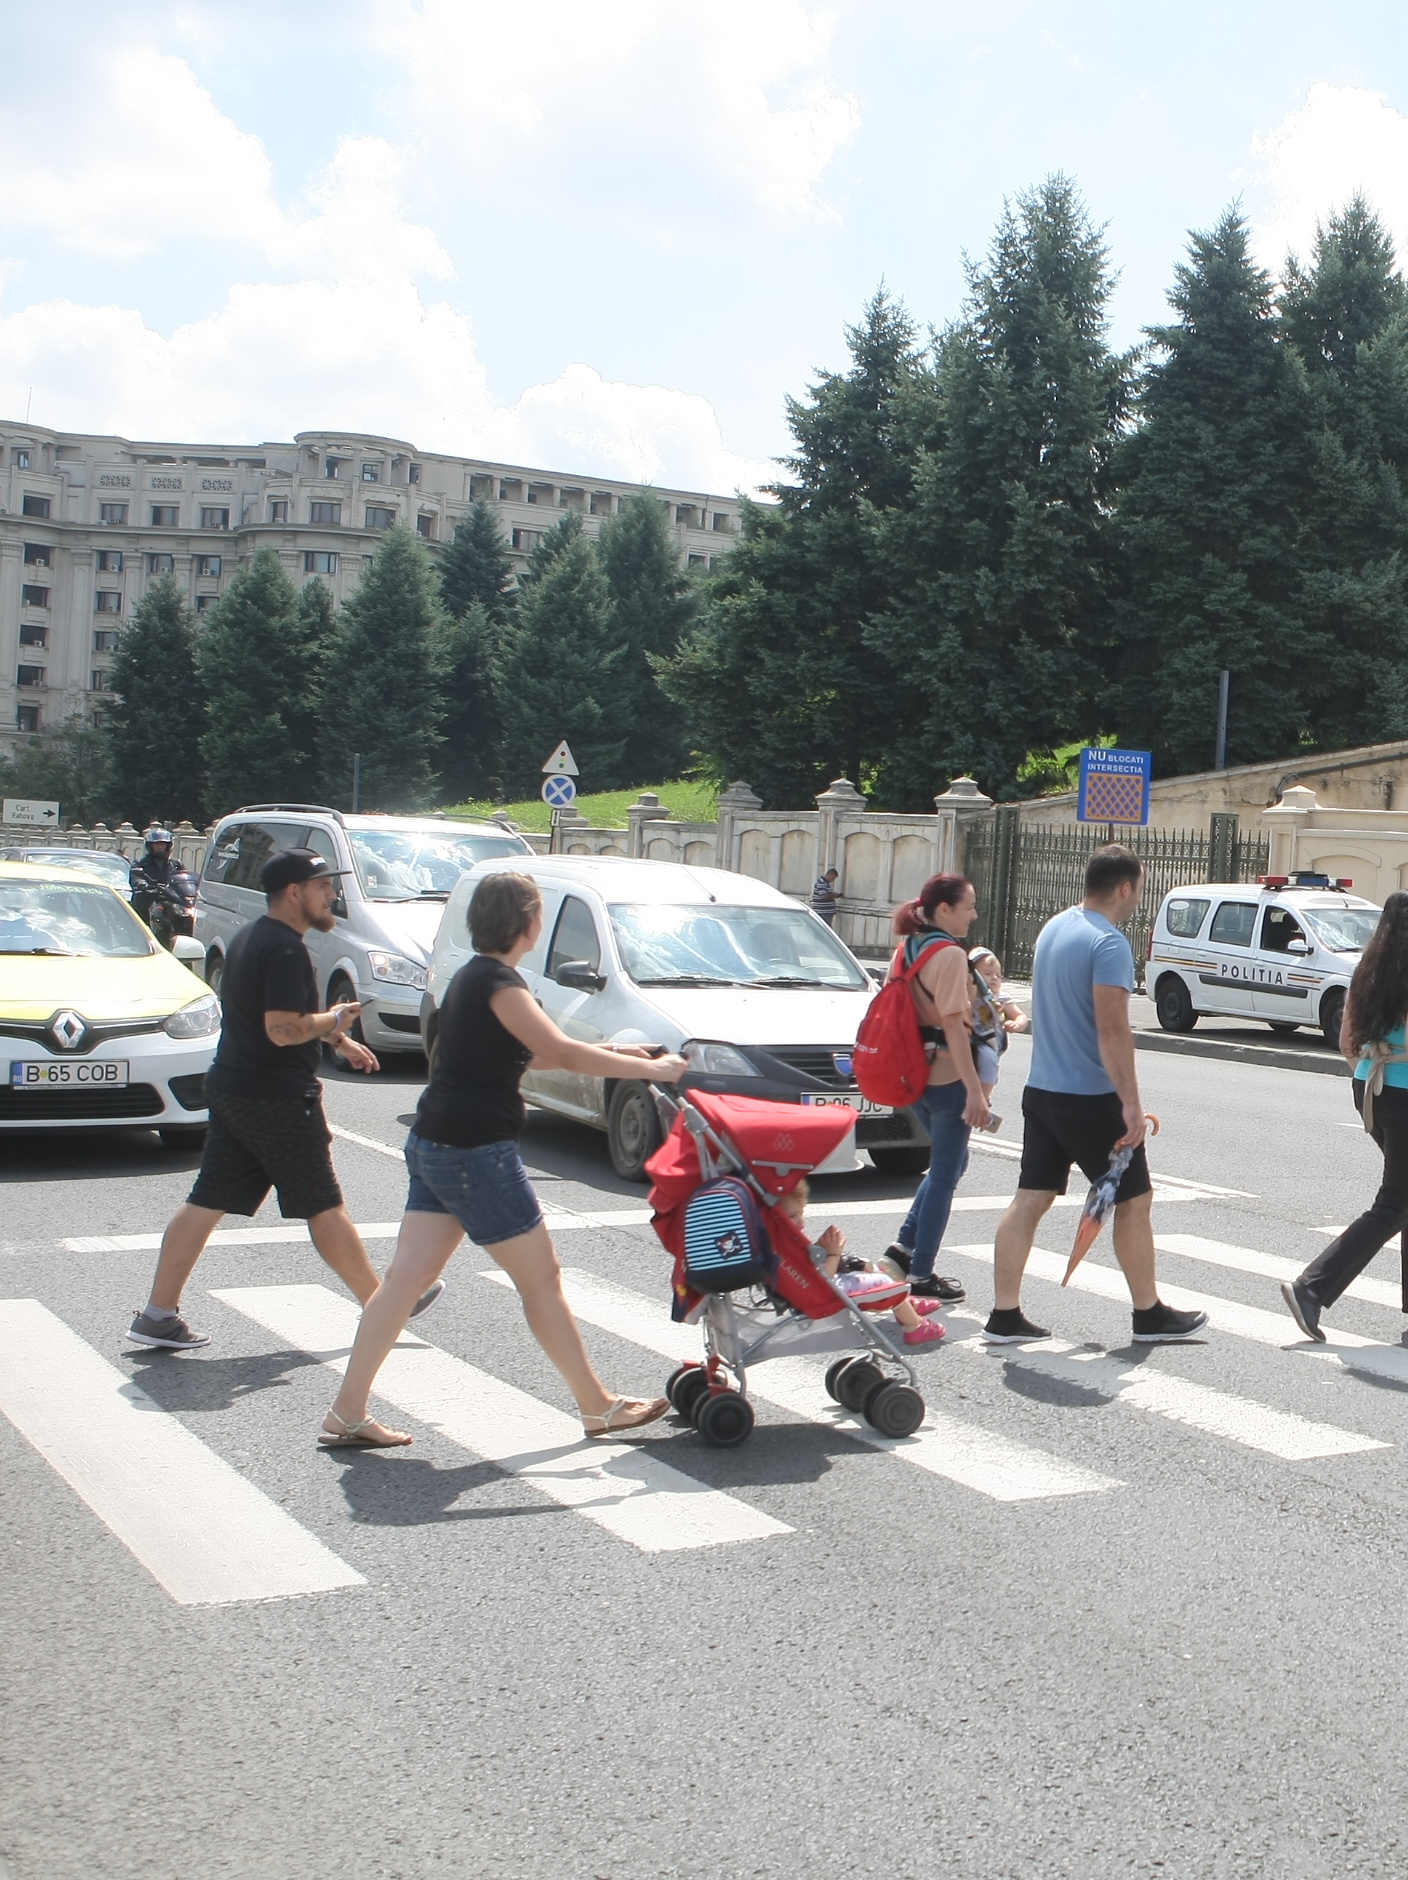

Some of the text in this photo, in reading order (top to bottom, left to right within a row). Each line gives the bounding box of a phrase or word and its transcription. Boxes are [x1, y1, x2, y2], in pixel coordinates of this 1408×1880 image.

[1088, 750, 1144, 764] NU BLOCATI
[1087, 763, 1143, 774] INTERSECTIA
[1221, 963, 1283, 985] POLITIA
[26, 1064, 118, 1083] B 65 COB
[780, 1260, 810, 1289] LAREN
